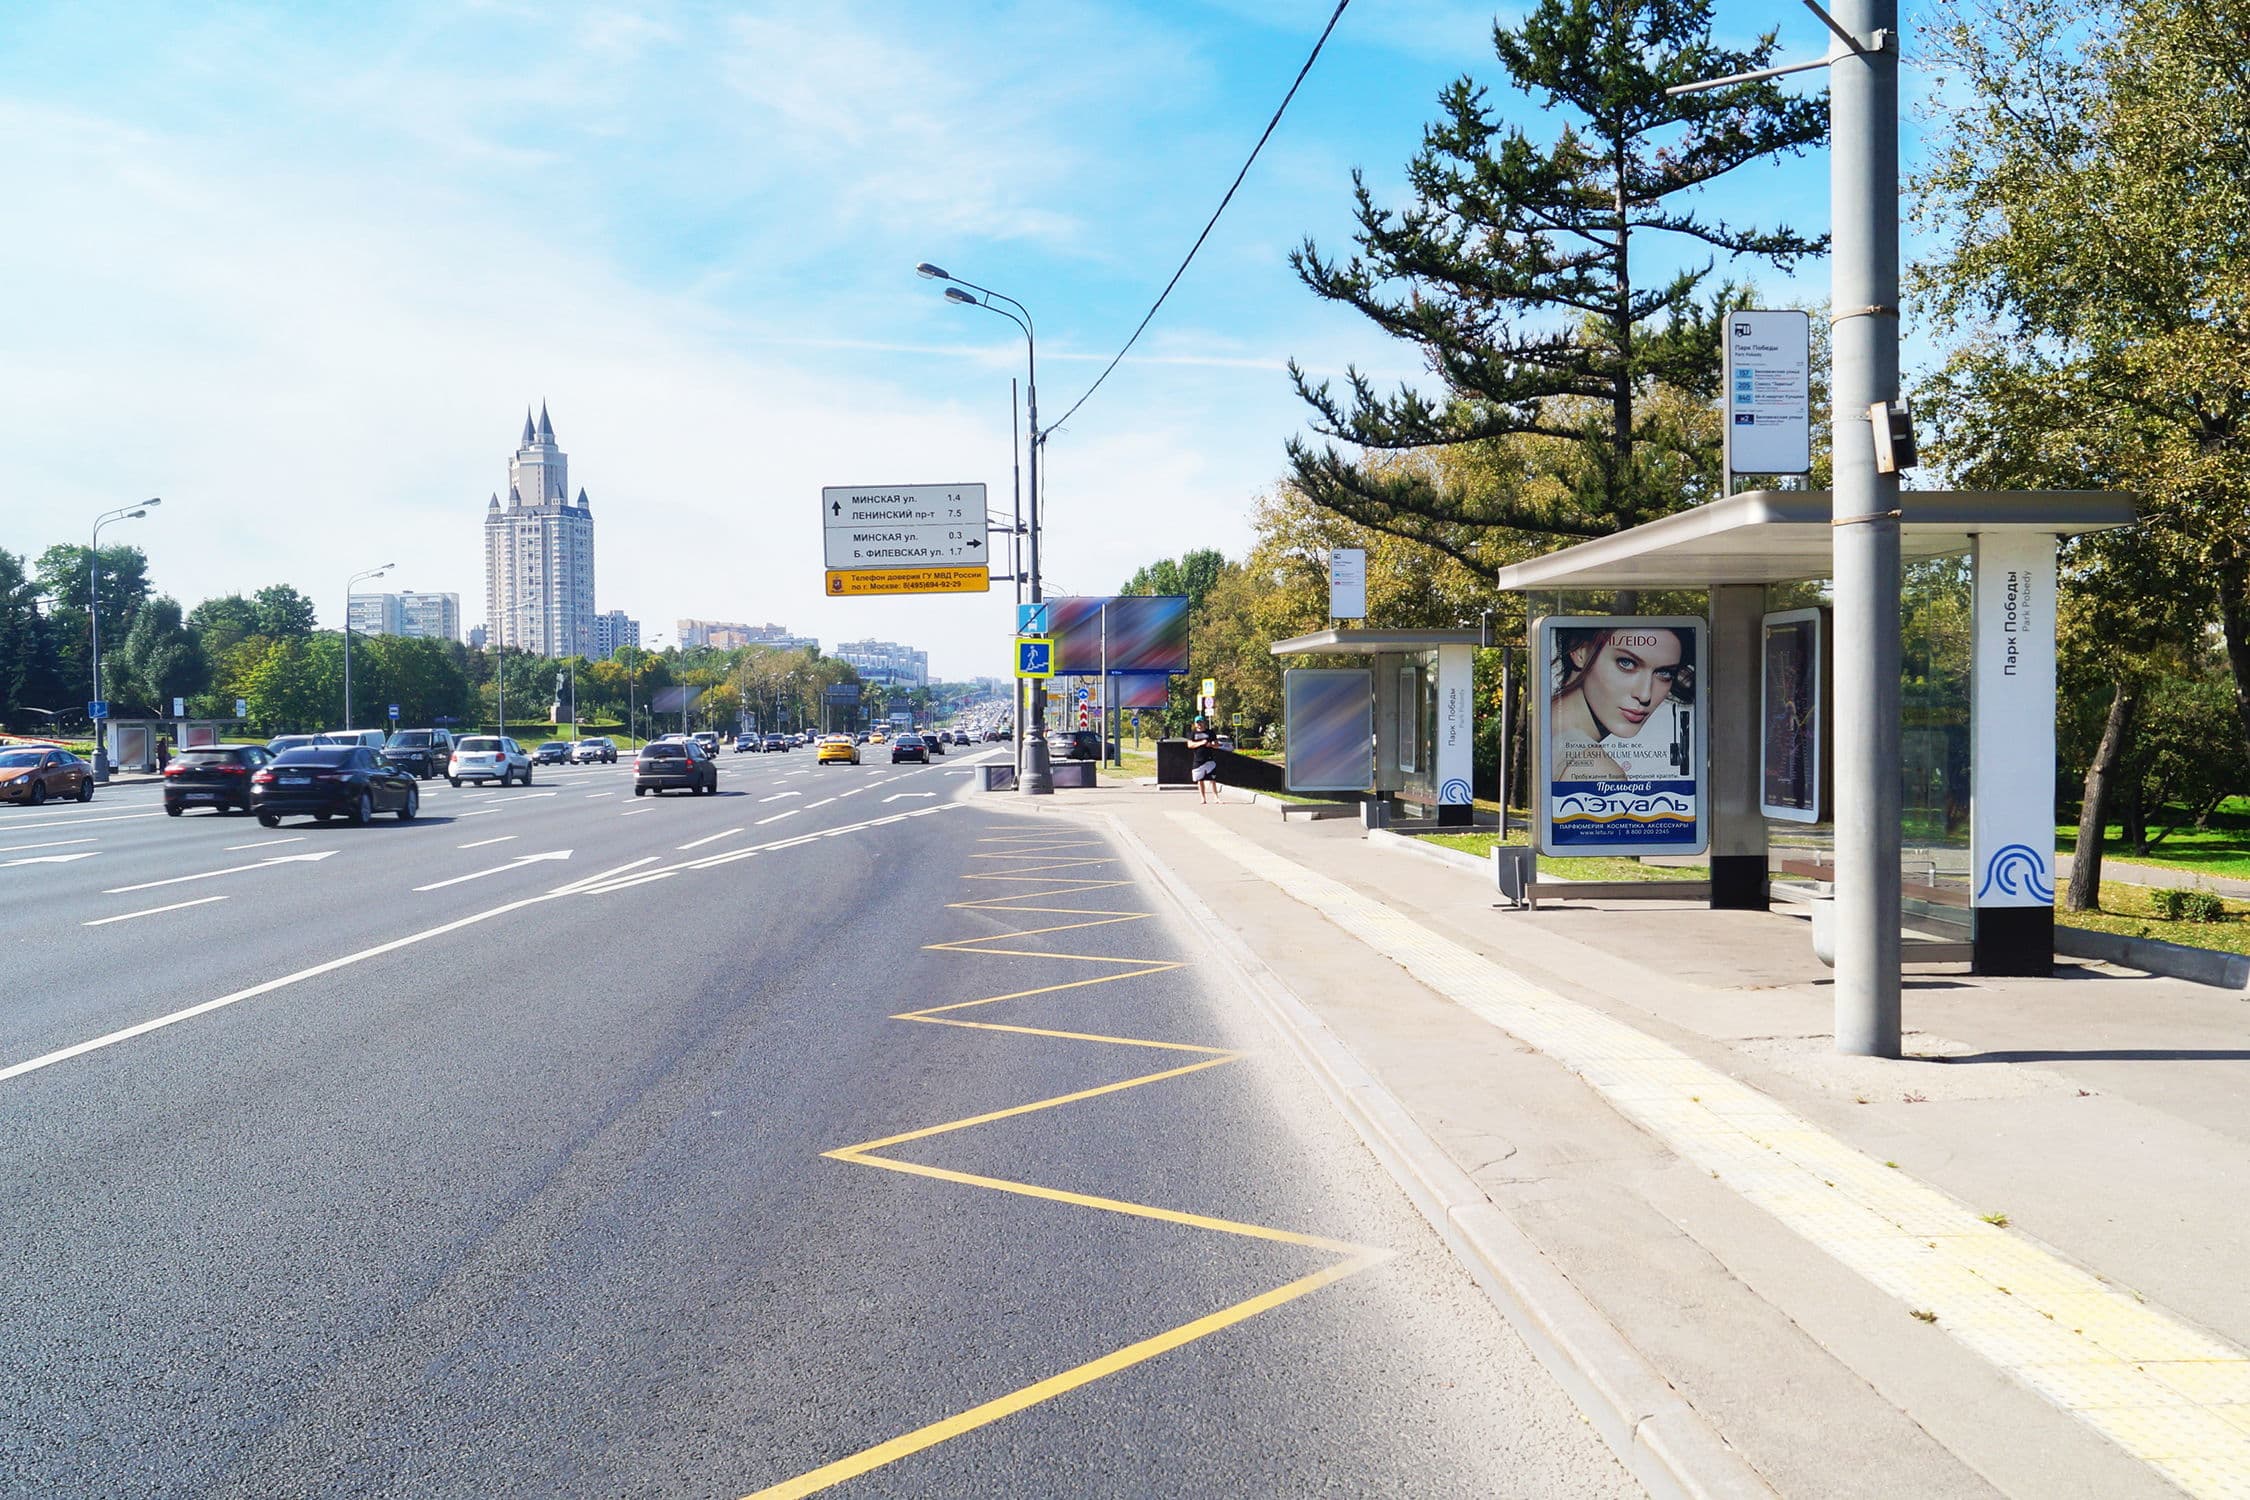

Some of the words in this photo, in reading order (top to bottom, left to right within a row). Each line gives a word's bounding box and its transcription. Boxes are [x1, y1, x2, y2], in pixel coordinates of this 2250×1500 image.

[852, 496, 900, 504] МИНСКАЯ
[852, 510, 912, 520] ЛЕНИНСКИЙ
[853, 533, 902, 542] МИНСКАЯ
[854, 550, 863, 558] Б.
[866, 548, 927, 557] ФИЛЕВСКАЯ
[2022, 571, 2032, 607] Pobedy
[2005, 572, 2018, 632] Победы
[2004, 637, 2019, 675] Парк
[1448, 688, 1456, 722] Победы
[1448, 726, 1457, 746] Парк
[1597, 782, 1643, 793] Премьера
[1644, 782, 1651, 791] в
